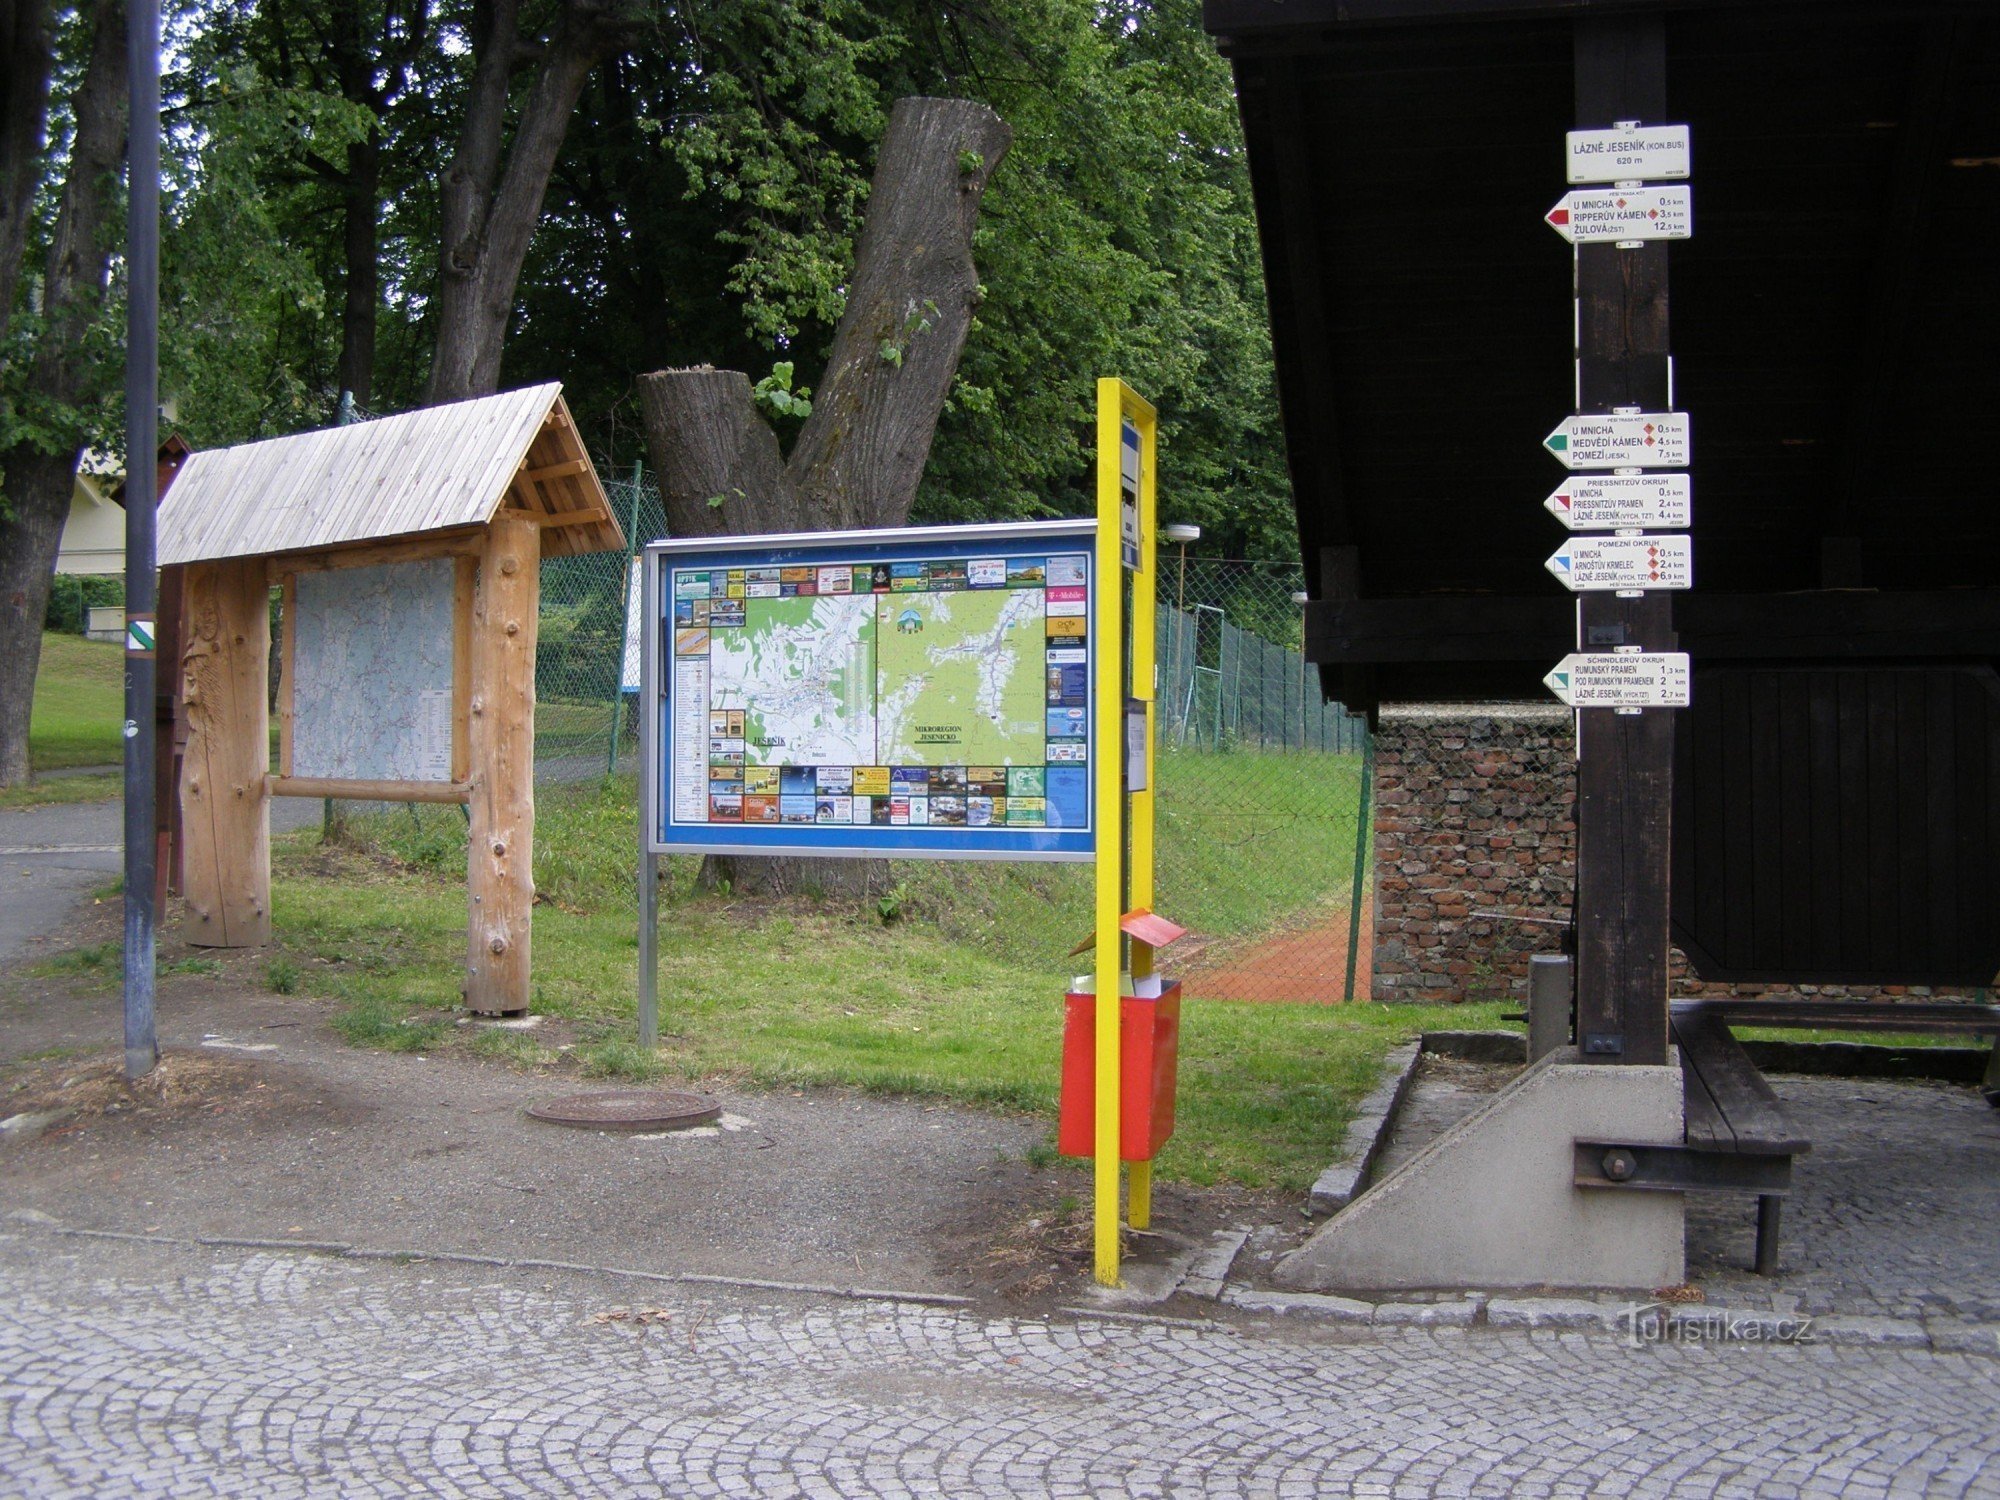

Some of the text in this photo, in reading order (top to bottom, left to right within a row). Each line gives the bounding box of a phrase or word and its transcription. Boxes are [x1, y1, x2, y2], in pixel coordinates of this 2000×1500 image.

[1574, 142, 1604, 154] LÁZNĚ
[1607, 140, 1645, 152] JESENÍK
[1582, 200, 1613, 209] MNICHA
[1660, 198, 1671, 206] 0,5
[1574, 211, 1614, 221] RIPPERŮV
[1617, 210, 1646, 219] KÁMEN
[1660, 210, 1671, 218] 3,5
[1655, 222, 1671, 230] 12,5
[1573, 427, 1578, 435] U
[1581, 426, 1614, 434] MNICHA
[1658, 425, 1669, 433] 0,5
[1573, 437, 1610, 447] MEDVĚDÍ
[1613, 436, 1642, 446] KÁMEN
[1658, 437, 1670, 445] 4,5
[1573, 450, 1604, 459] POMEZÍ
[1658, 450, 1670, 458] 7,5
[1580, 489, 1602, 497] MNICHA
[1659, 488, 1671, 496] 0,5
[1574, 499, 1616, 508] PRIESSNITZŮV
[1618, 500, 1643, 508] PRAMEN
[1659, 500, 1670, 508] 2,4
[1574, 510, 1593, 520] LÁZNĚ
[1595, 509, 1619, 519] JESENÍK
[1659, 511, 1670, 519] 4,4
[1660, 549, 1671, 557] 0,5
[1575, 560, 1605, 570] ARNOŠTŮV
[1607, 561, 1633, 569] KRMELEC
[1660, 560, 1671, 568] 2,4
[1575, 572, 1592, 581] LÁZNĚ
[1594, 570, 1617, 581] JESENÍK
[1660, 572, 1672, 580] 6,9
[1576, 665, 1609, 674] RUMUNSKÝ
[1661, 666, 1673, 674] 1,3
[1624, 677, 1654, 685] PRAMENEM
[1661, 677, 1666, 685] 2
[1576, 688, 1595, 698] LÁZNĚ
[1596, 687, 1622, 698] JESENÍK
[1661, 690, 1673, 698] 2,7
[914, 725, 962, 733] MIKROREGION
[752, 735, 786, 746] JESENÍK
[920, 733, 956, 741] JESENICKO
